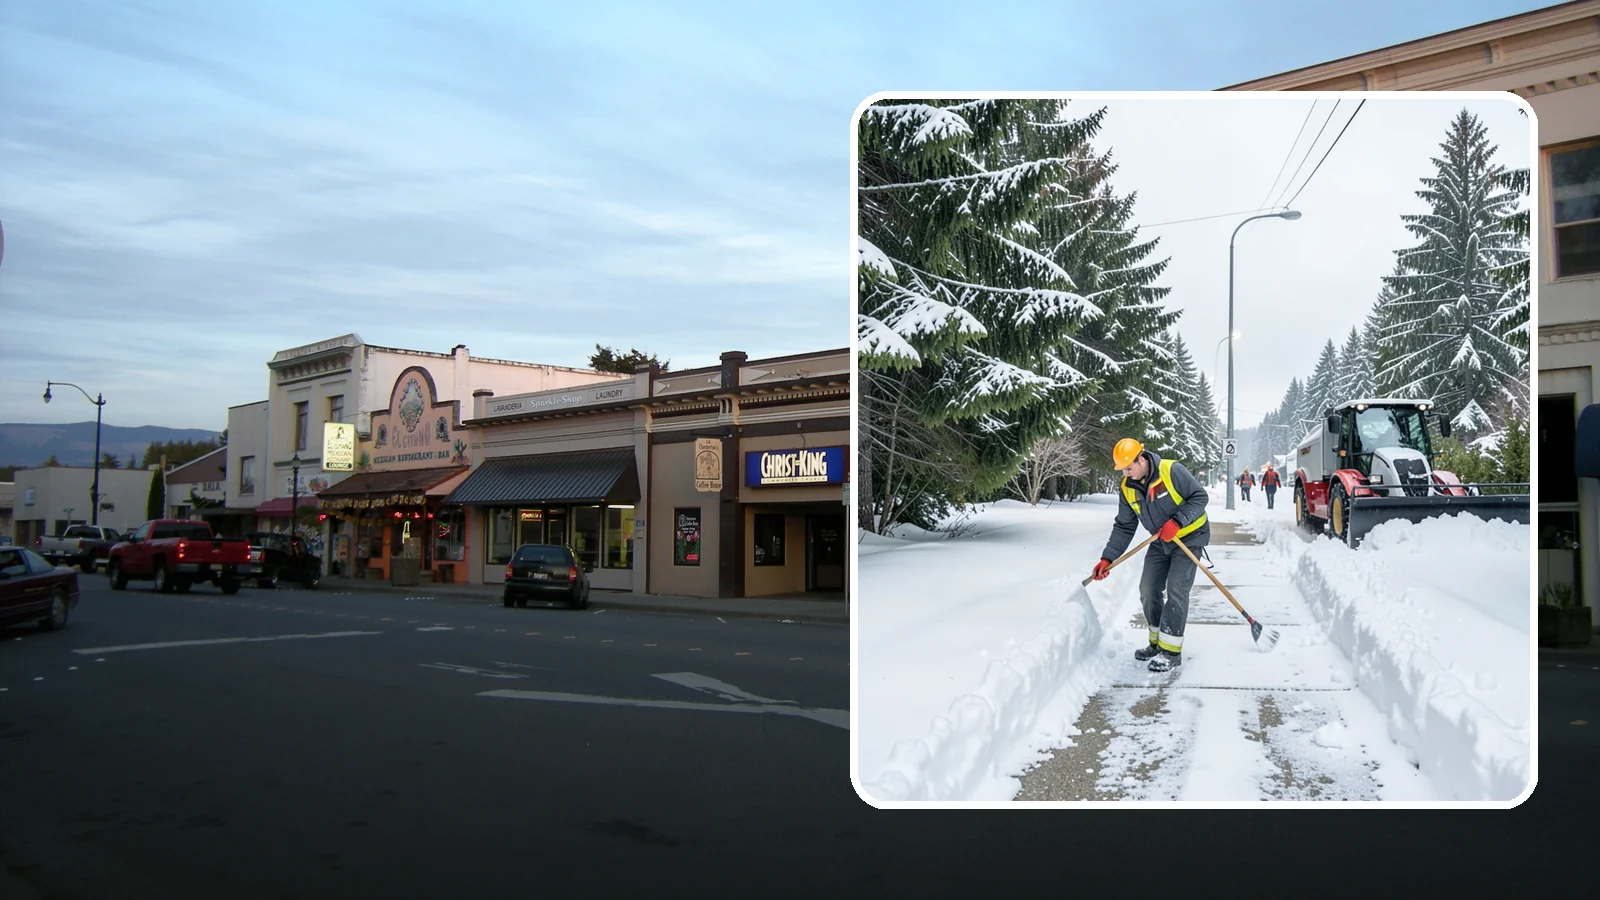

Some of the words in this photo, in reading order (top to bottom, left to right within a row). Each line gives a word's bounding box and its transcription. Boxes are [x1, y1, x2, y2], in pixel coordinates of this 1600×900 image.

[561, 394, 583, 405] Shop
[595, 389, 624, 400] LAUNDRY
[493, 402, 523, 413] LAVANDERIA
[373, 454, 396, 464] MEXICAN
[397, 451, 434, 462] RESTAURANT
[437, 450, 450, 459] BAR
[761, 452, 797, 478] CHRIST
[799, 450, 828, 477] KING
[696, 480, 709, 489] Coffee
